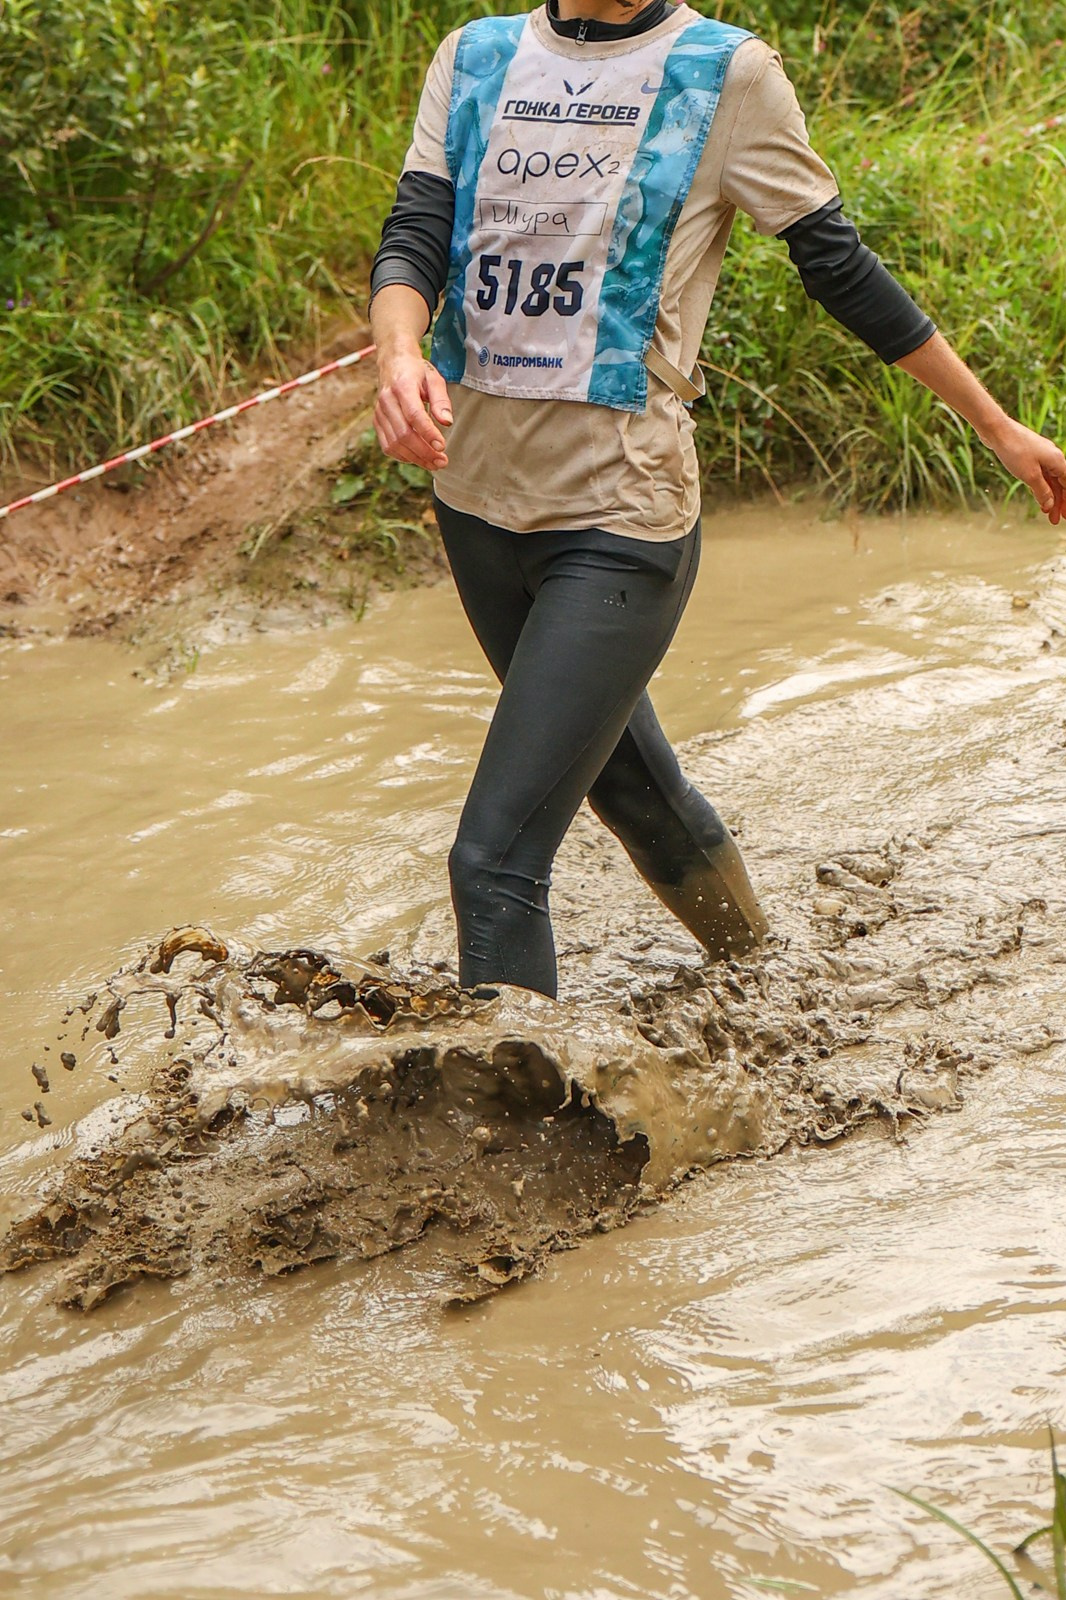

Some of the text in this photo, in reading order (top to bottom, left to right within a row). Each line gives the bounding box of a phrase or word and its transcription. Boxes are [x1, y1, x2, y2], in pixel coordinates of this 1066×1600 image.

[503, 100, 641, 121] ГОНКА ГЕРОЕВ
[492, 203, 571, 234] Шура
[476, 253, 585, 318] 5185
[493, 353, 564, 370] ГАЗПРОМБАНК
